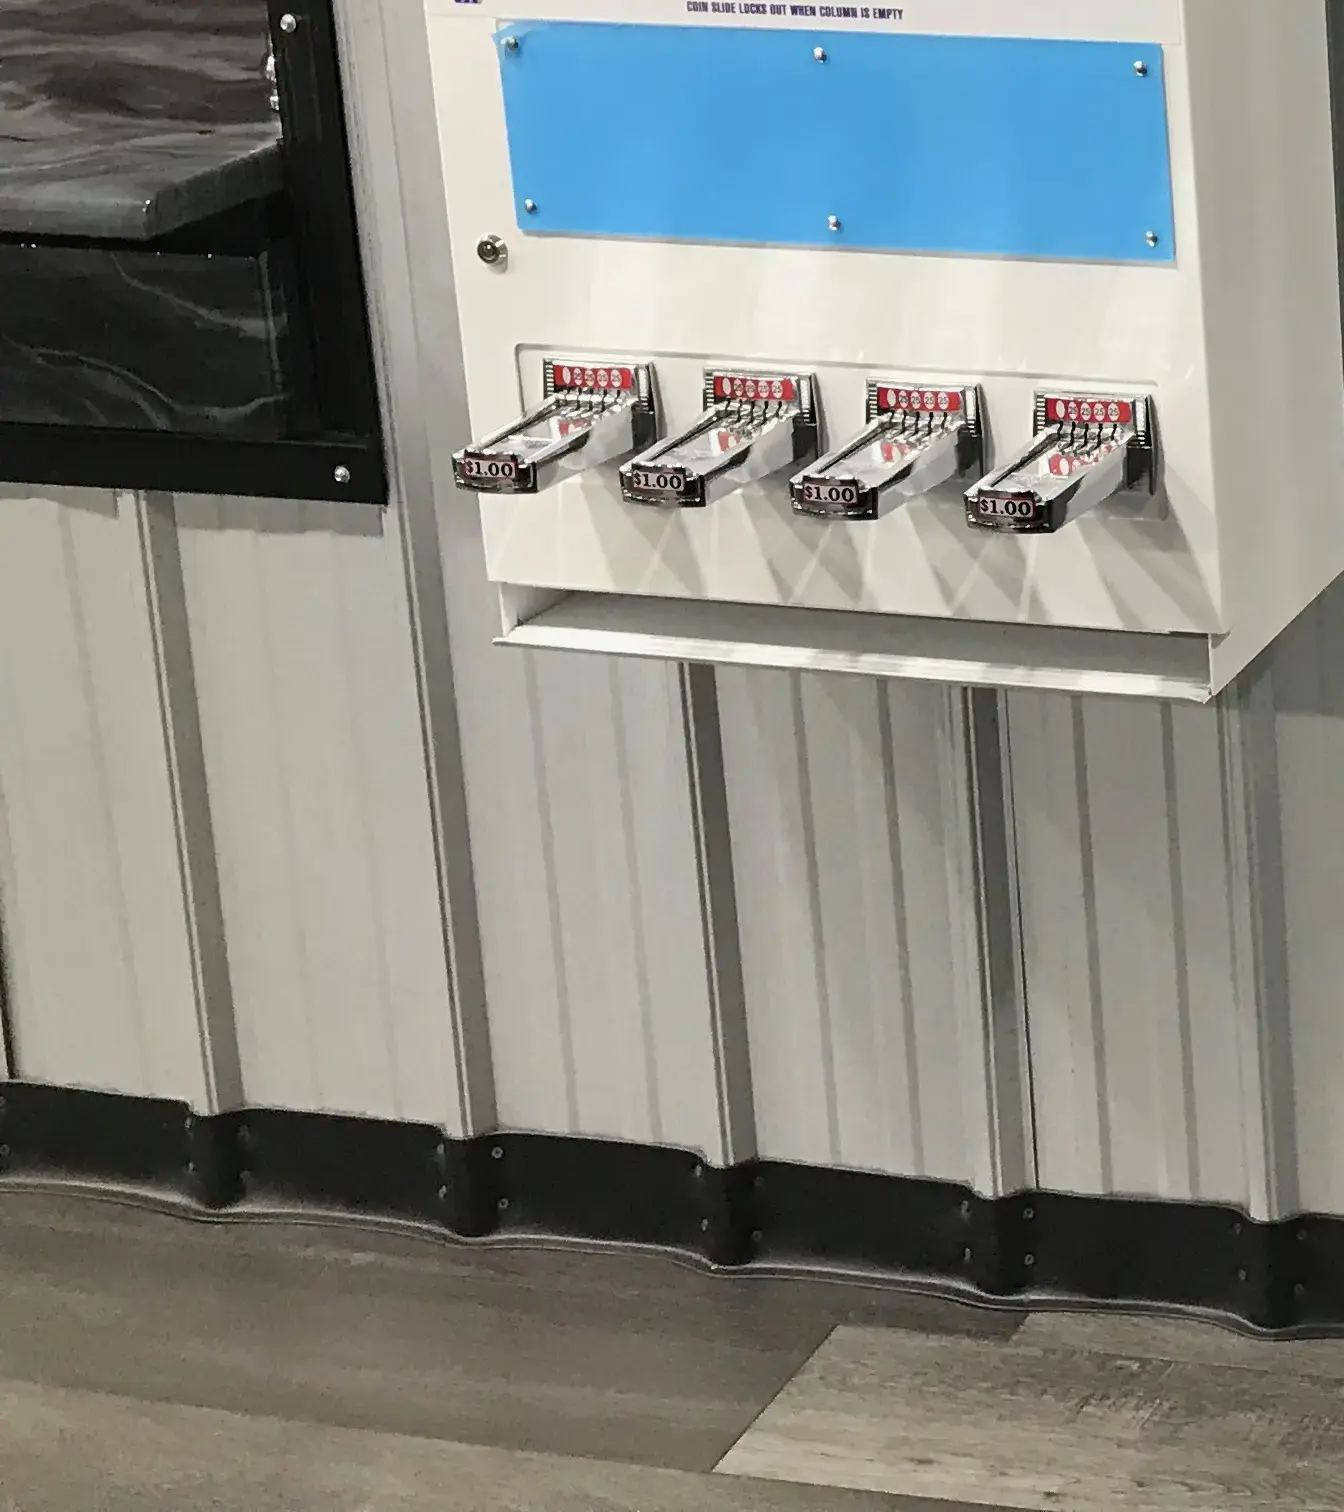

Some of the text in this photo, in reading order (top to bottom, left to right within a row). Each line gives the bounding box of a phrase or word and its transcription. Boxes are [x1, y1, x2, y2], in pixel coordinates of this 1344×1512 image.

[687, 1, 903, 20] COIN SLIDE LOCKS OUT WHEN COLUMN IS EMPTY
[465, 460, 513, 477] $1.00
[633, 470, 681, 489] $1.00
[804, 485, 854, 502] $1.00
[980, 499, 1031, 516] $1.00
